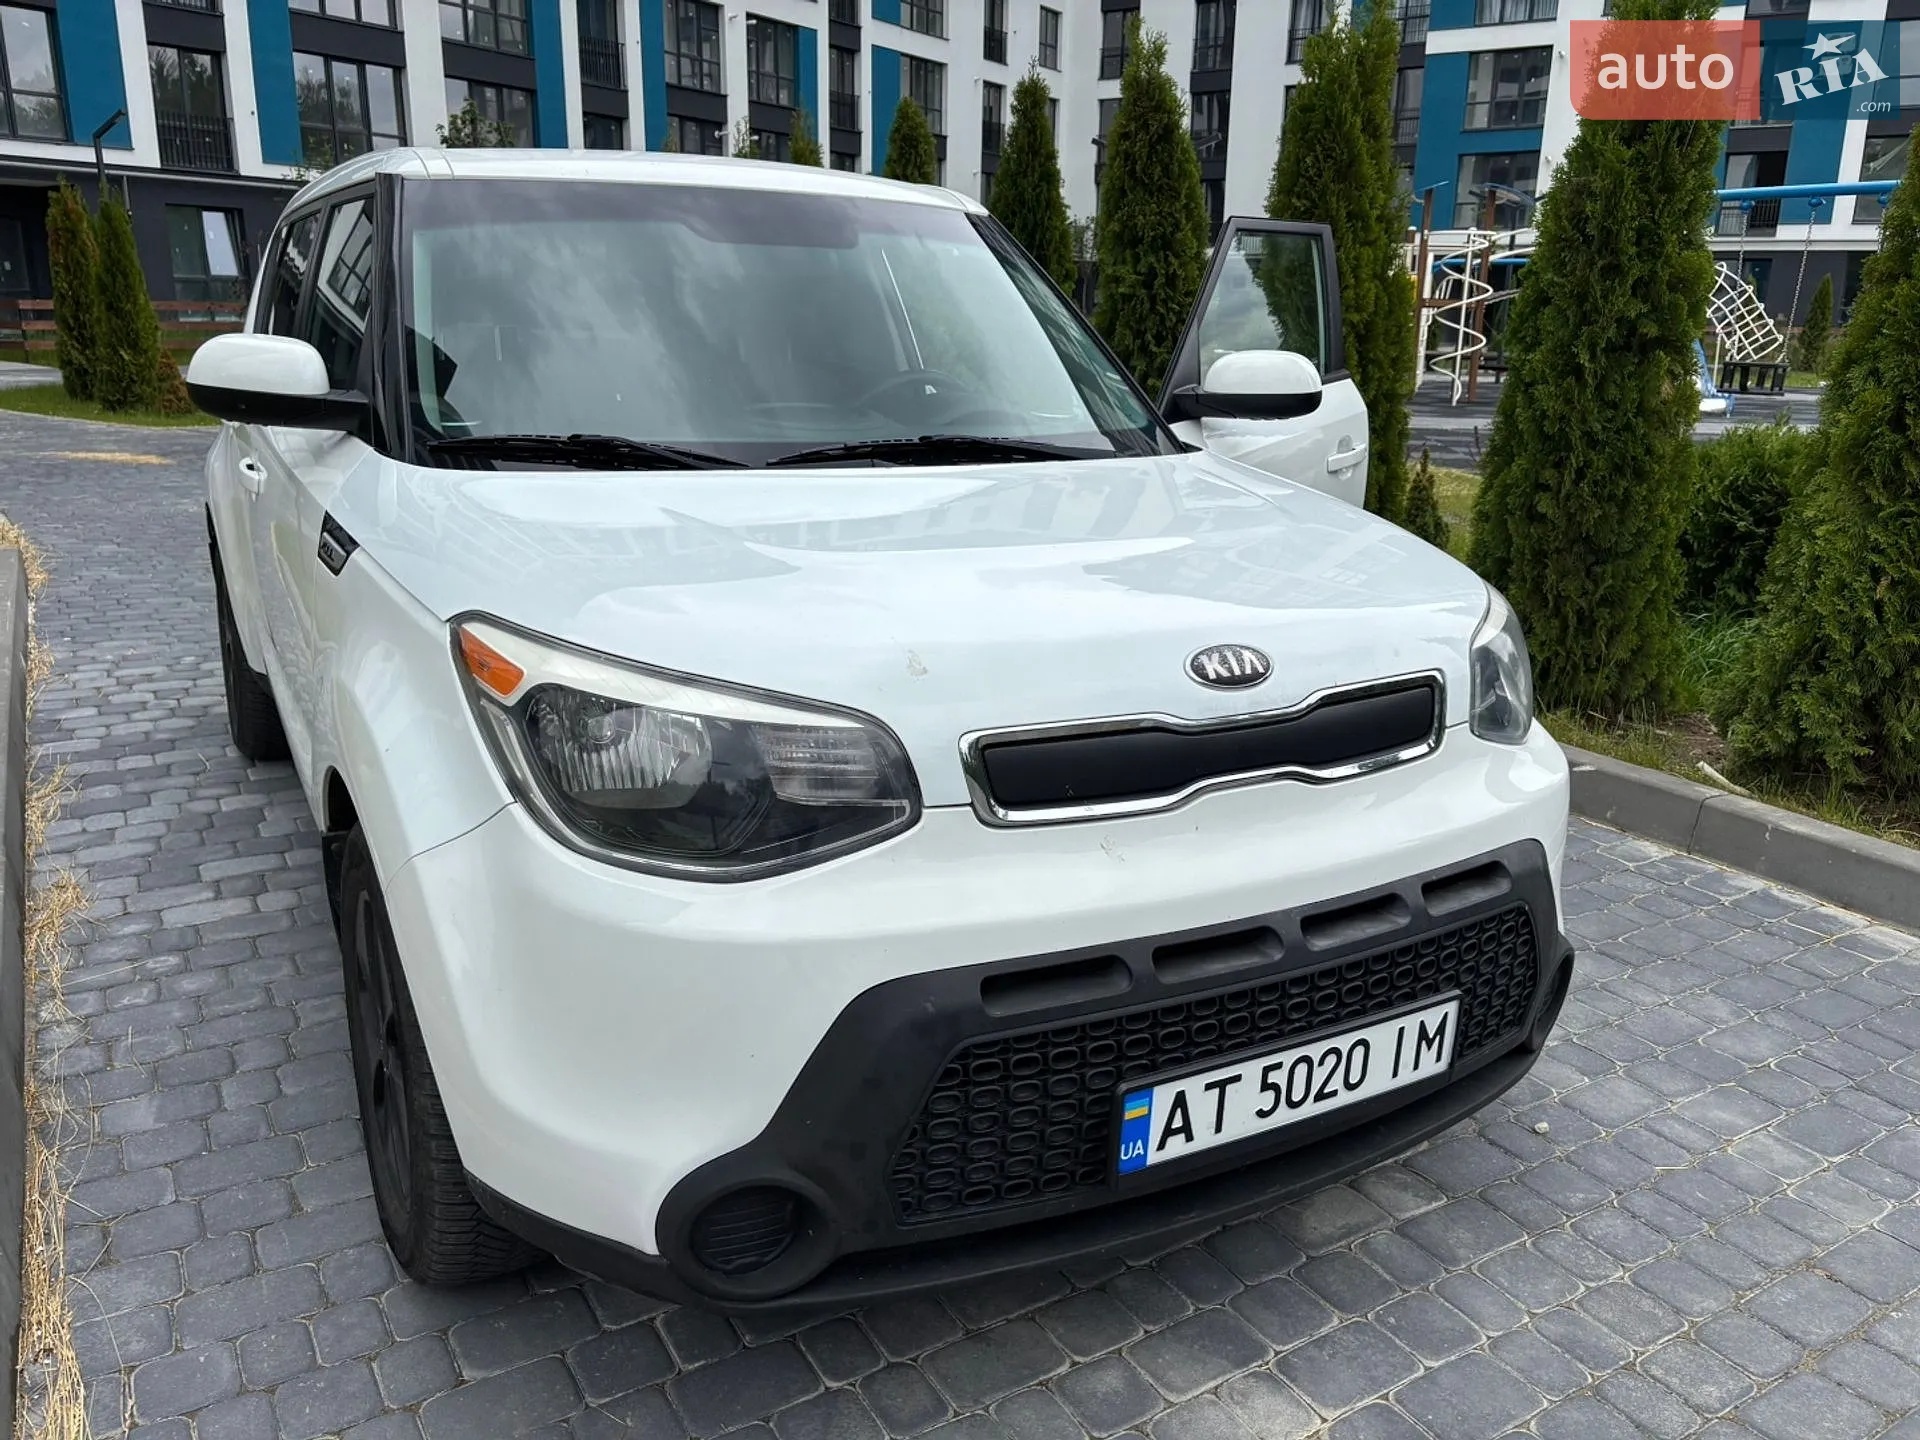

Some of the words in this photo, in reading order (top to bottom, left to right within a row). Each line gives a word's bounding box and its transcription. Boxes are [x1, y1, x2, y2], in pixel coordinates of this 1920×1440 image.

[1199, 650, 1265, 680] KIA
[1156, 1073, 1243, 1151] AT
[1255, 1037, 1371, 1119] 5020
[1392, 1010, 1449, 1079] IM
[1120, 1139, 1144, 1161] UA
